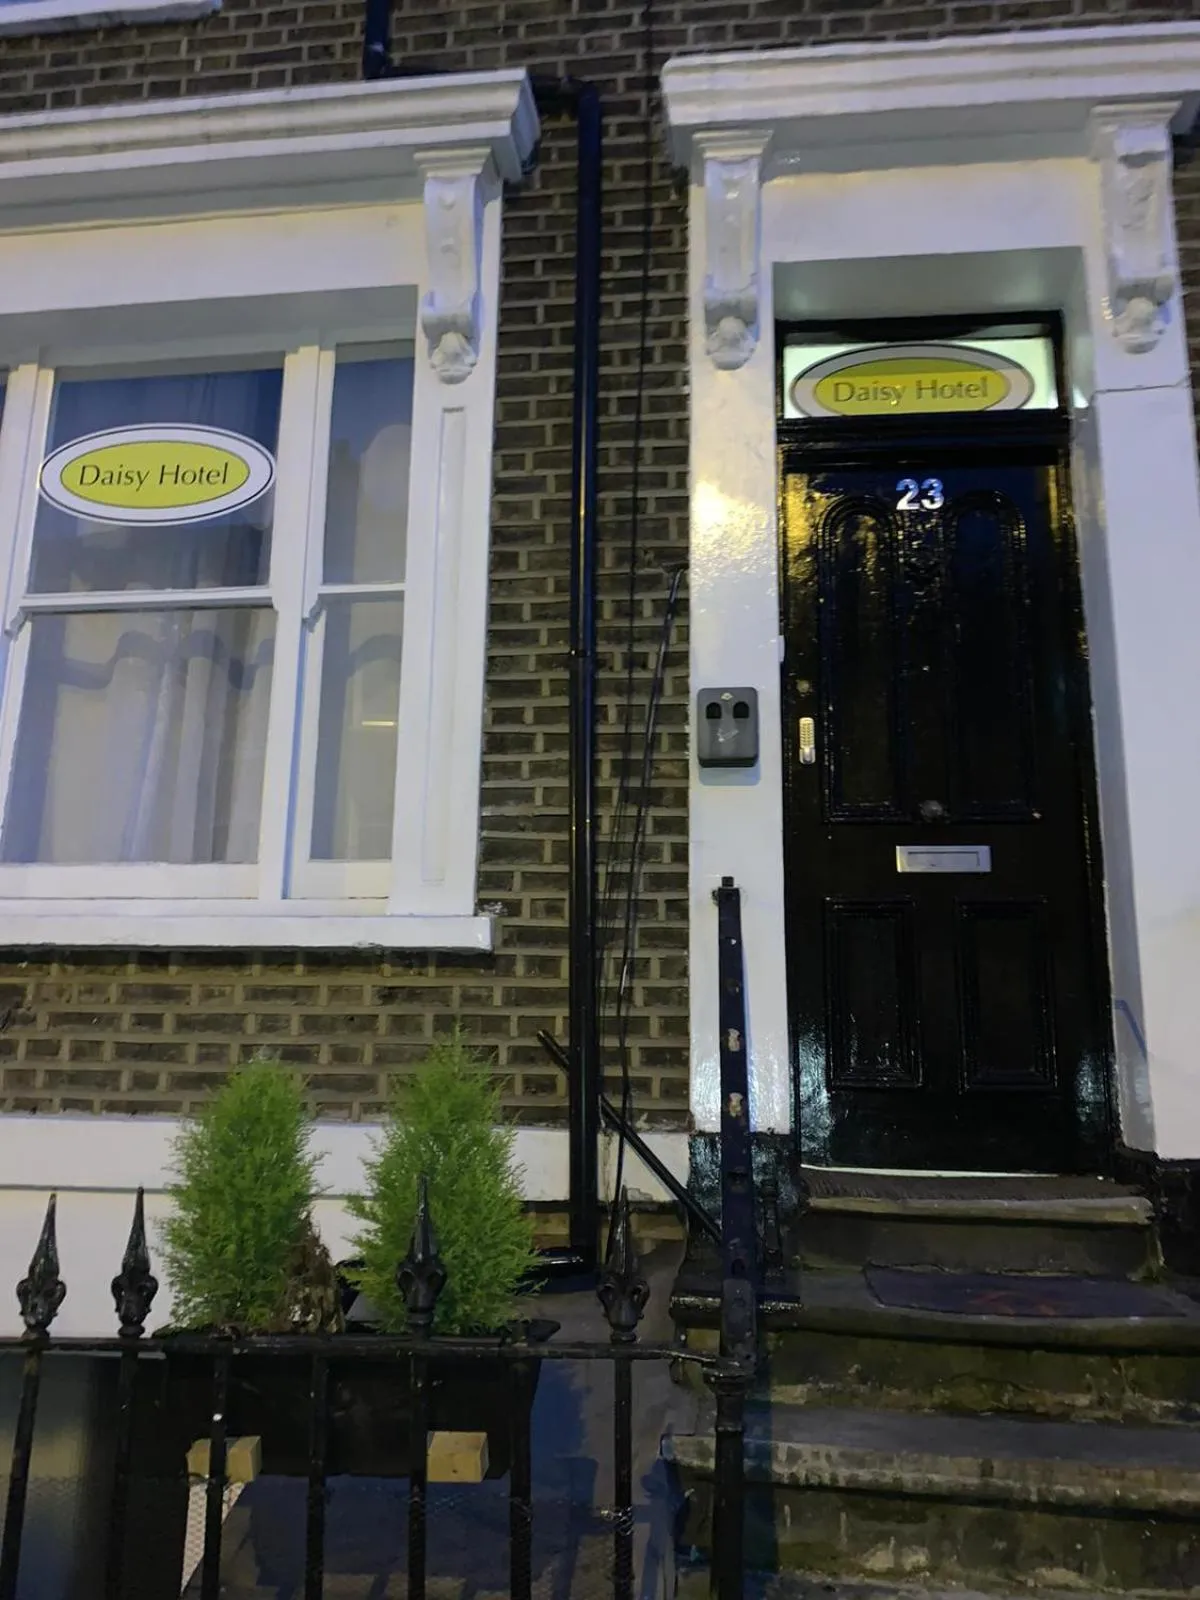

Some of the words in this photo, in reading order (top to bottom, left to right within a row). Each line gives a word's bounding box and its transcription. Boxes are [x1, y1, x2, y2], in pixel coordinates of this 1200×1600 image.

[832, 380, 906, 407] Daisy
[915, 376, 989, 400] Hotel
[78, 463, 150, 492] Daisy
[158, 461, 229, 485] Hotel
[895, 478, 944, 510] 23
